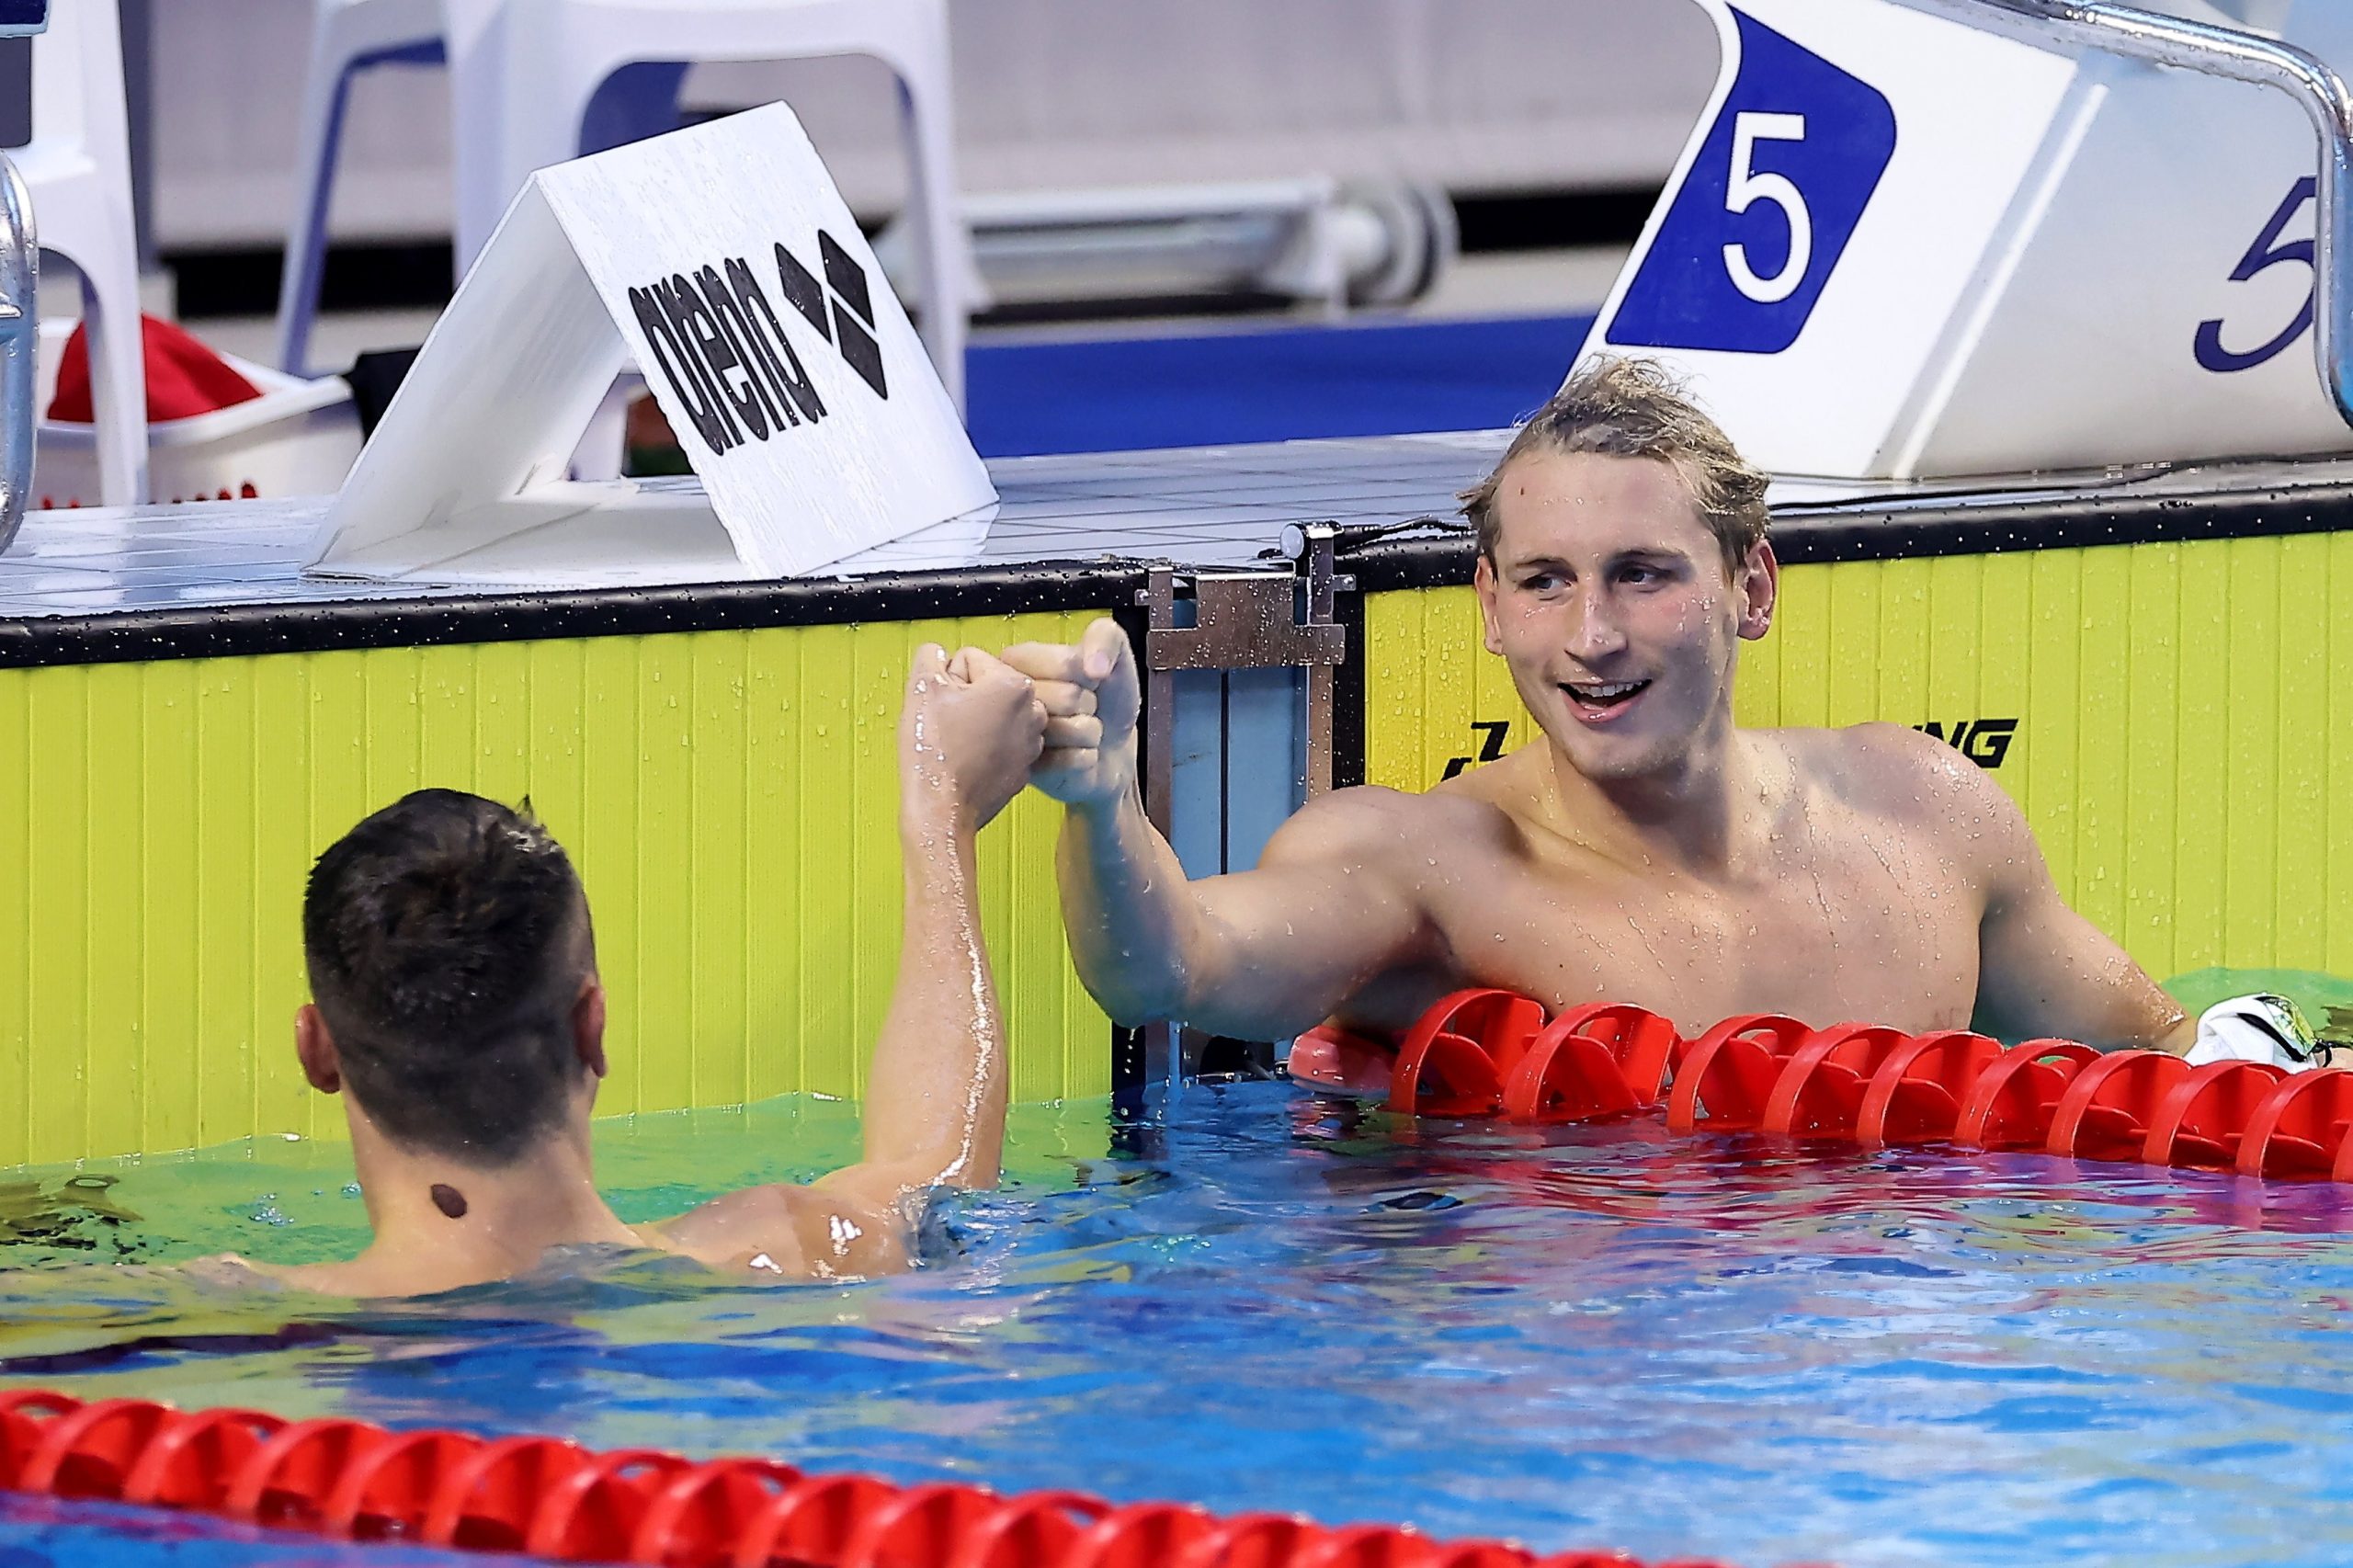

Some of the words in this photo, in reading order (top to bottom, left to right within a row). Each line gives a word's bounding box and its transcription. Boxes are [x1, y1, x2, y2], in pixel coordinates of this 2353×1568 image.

[1722, 110, 1813, 304] 5
[2194, 176, 2317, 373] 5
[628, 257, 828, 456] arena
